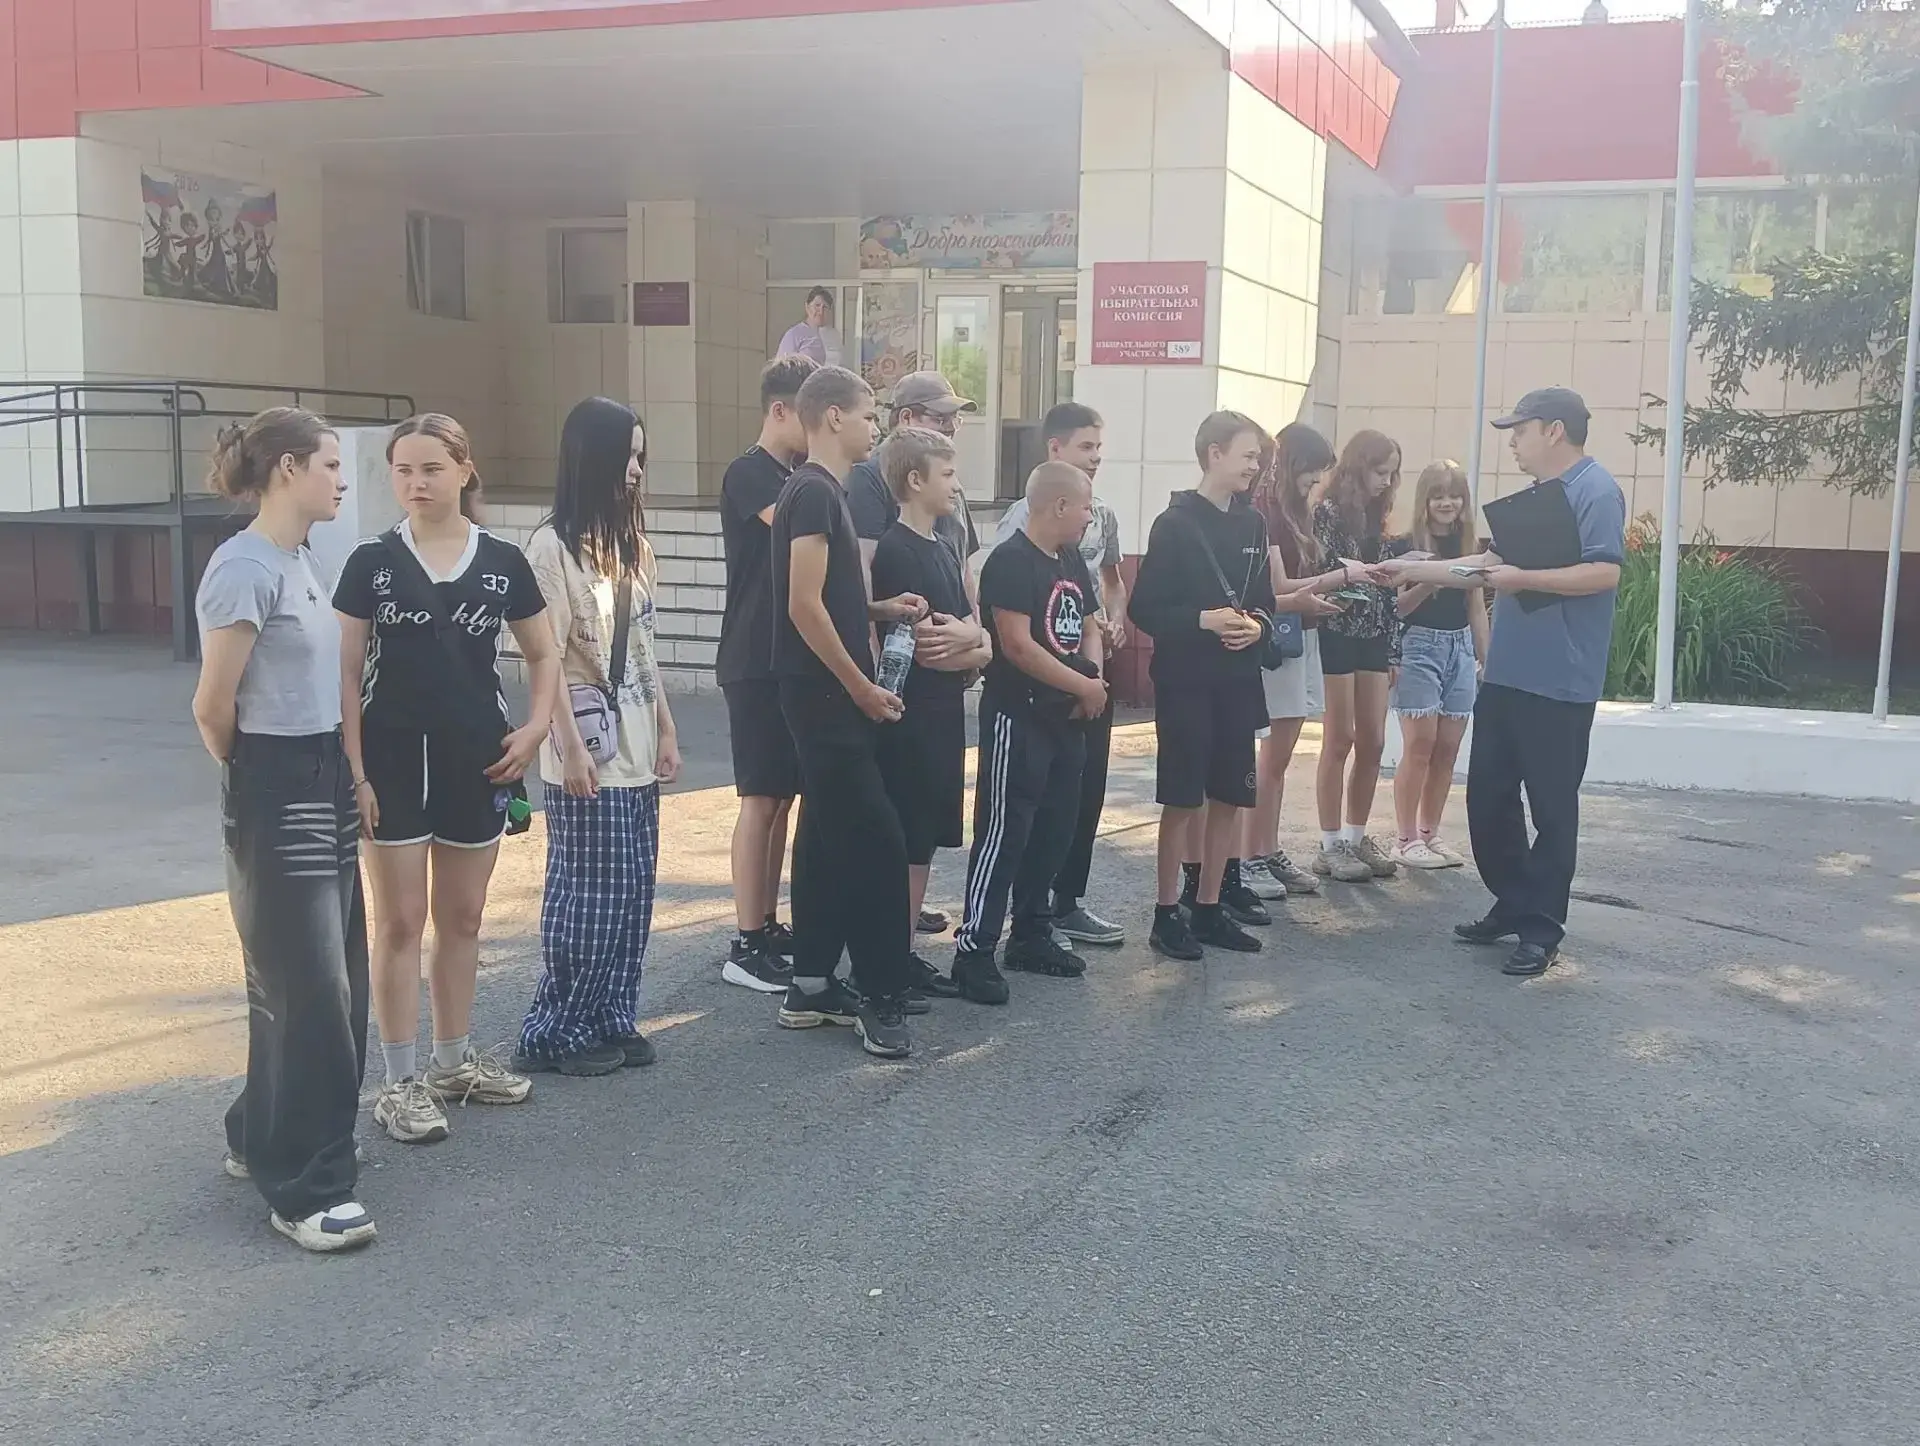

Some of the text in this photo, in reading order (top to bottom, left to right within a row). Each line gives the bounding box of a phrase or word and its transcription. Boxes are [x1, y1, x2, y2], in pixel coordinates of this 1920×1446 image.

[909, 226, 1077, 256] Добро пожаловат
[1110, 285, 1189, 295] УЧАСТКОВАЯ
[1100, 298, 1198, 308] ИЗБИРАТЕЛЬНАЯ
[1114, 311, 1183, 321] КОМИССИЯ
[1119, 350, 1156, 358] УЧАСТКА
[481, 573, 510, 595] 33
[376, 600, 501, 636] Broklyn
